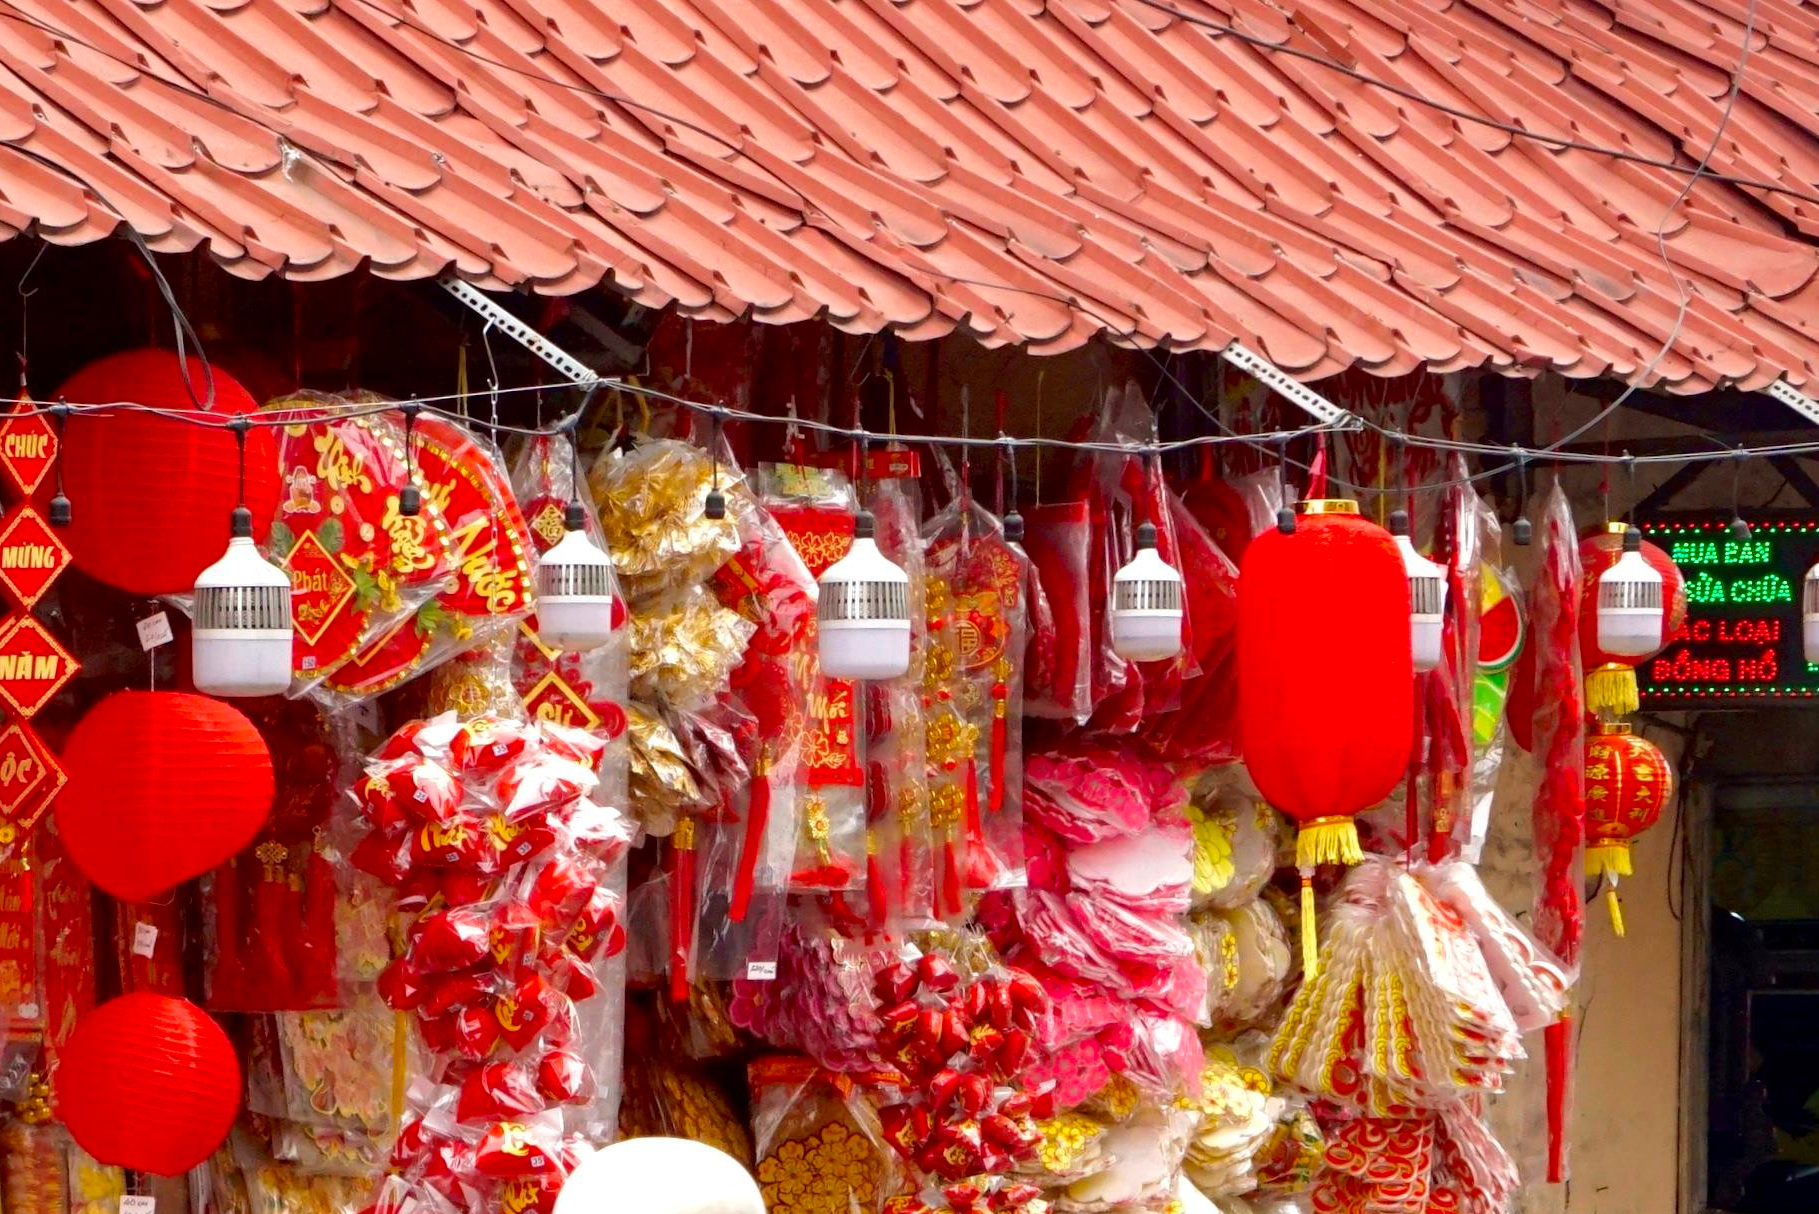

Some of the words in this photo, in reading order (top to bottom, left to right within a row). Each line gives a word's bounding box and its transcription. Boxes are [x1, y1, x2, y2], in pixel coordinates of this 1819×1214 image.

[4, 431, 48, 459] CHÚC
[1, 541, 55, 568] MỪNG
[1672, 542, 1718, 563] MUA
[293, 568, 329, 593] Phát
[1731, 574, 1792, 602] CHỮA
[1718, 620, 1780, 645] LOẠI
[1738, 649, 1778, 681] HỒ
